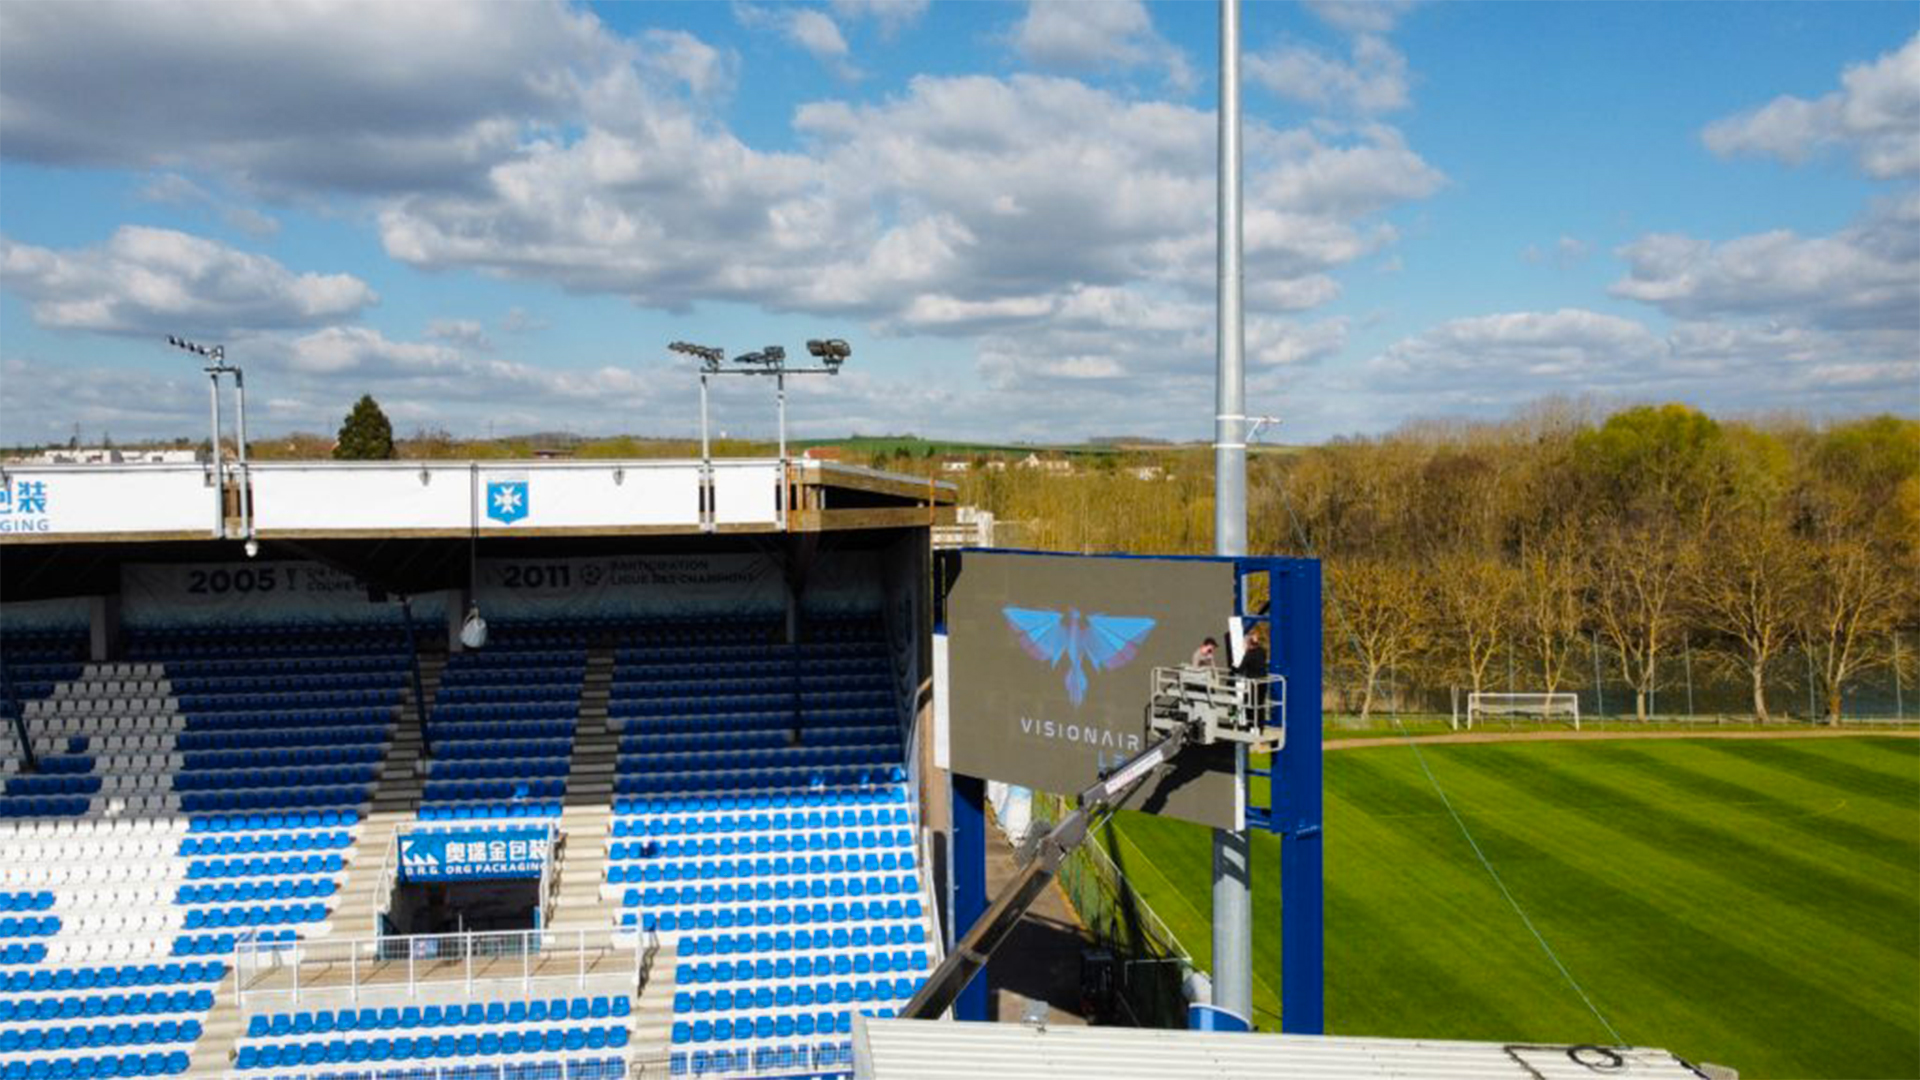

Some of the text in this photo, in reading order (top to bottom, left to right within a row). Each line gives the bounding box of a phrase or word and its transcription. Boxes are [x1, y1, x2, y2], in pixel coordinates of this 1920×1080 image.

[187, 568, 276, 594] 2005
[503, 565, 570, 588] 2011
[1020, 717, 1140, 752] VISIONAIR
[445, 865, 472, 875] ORG
